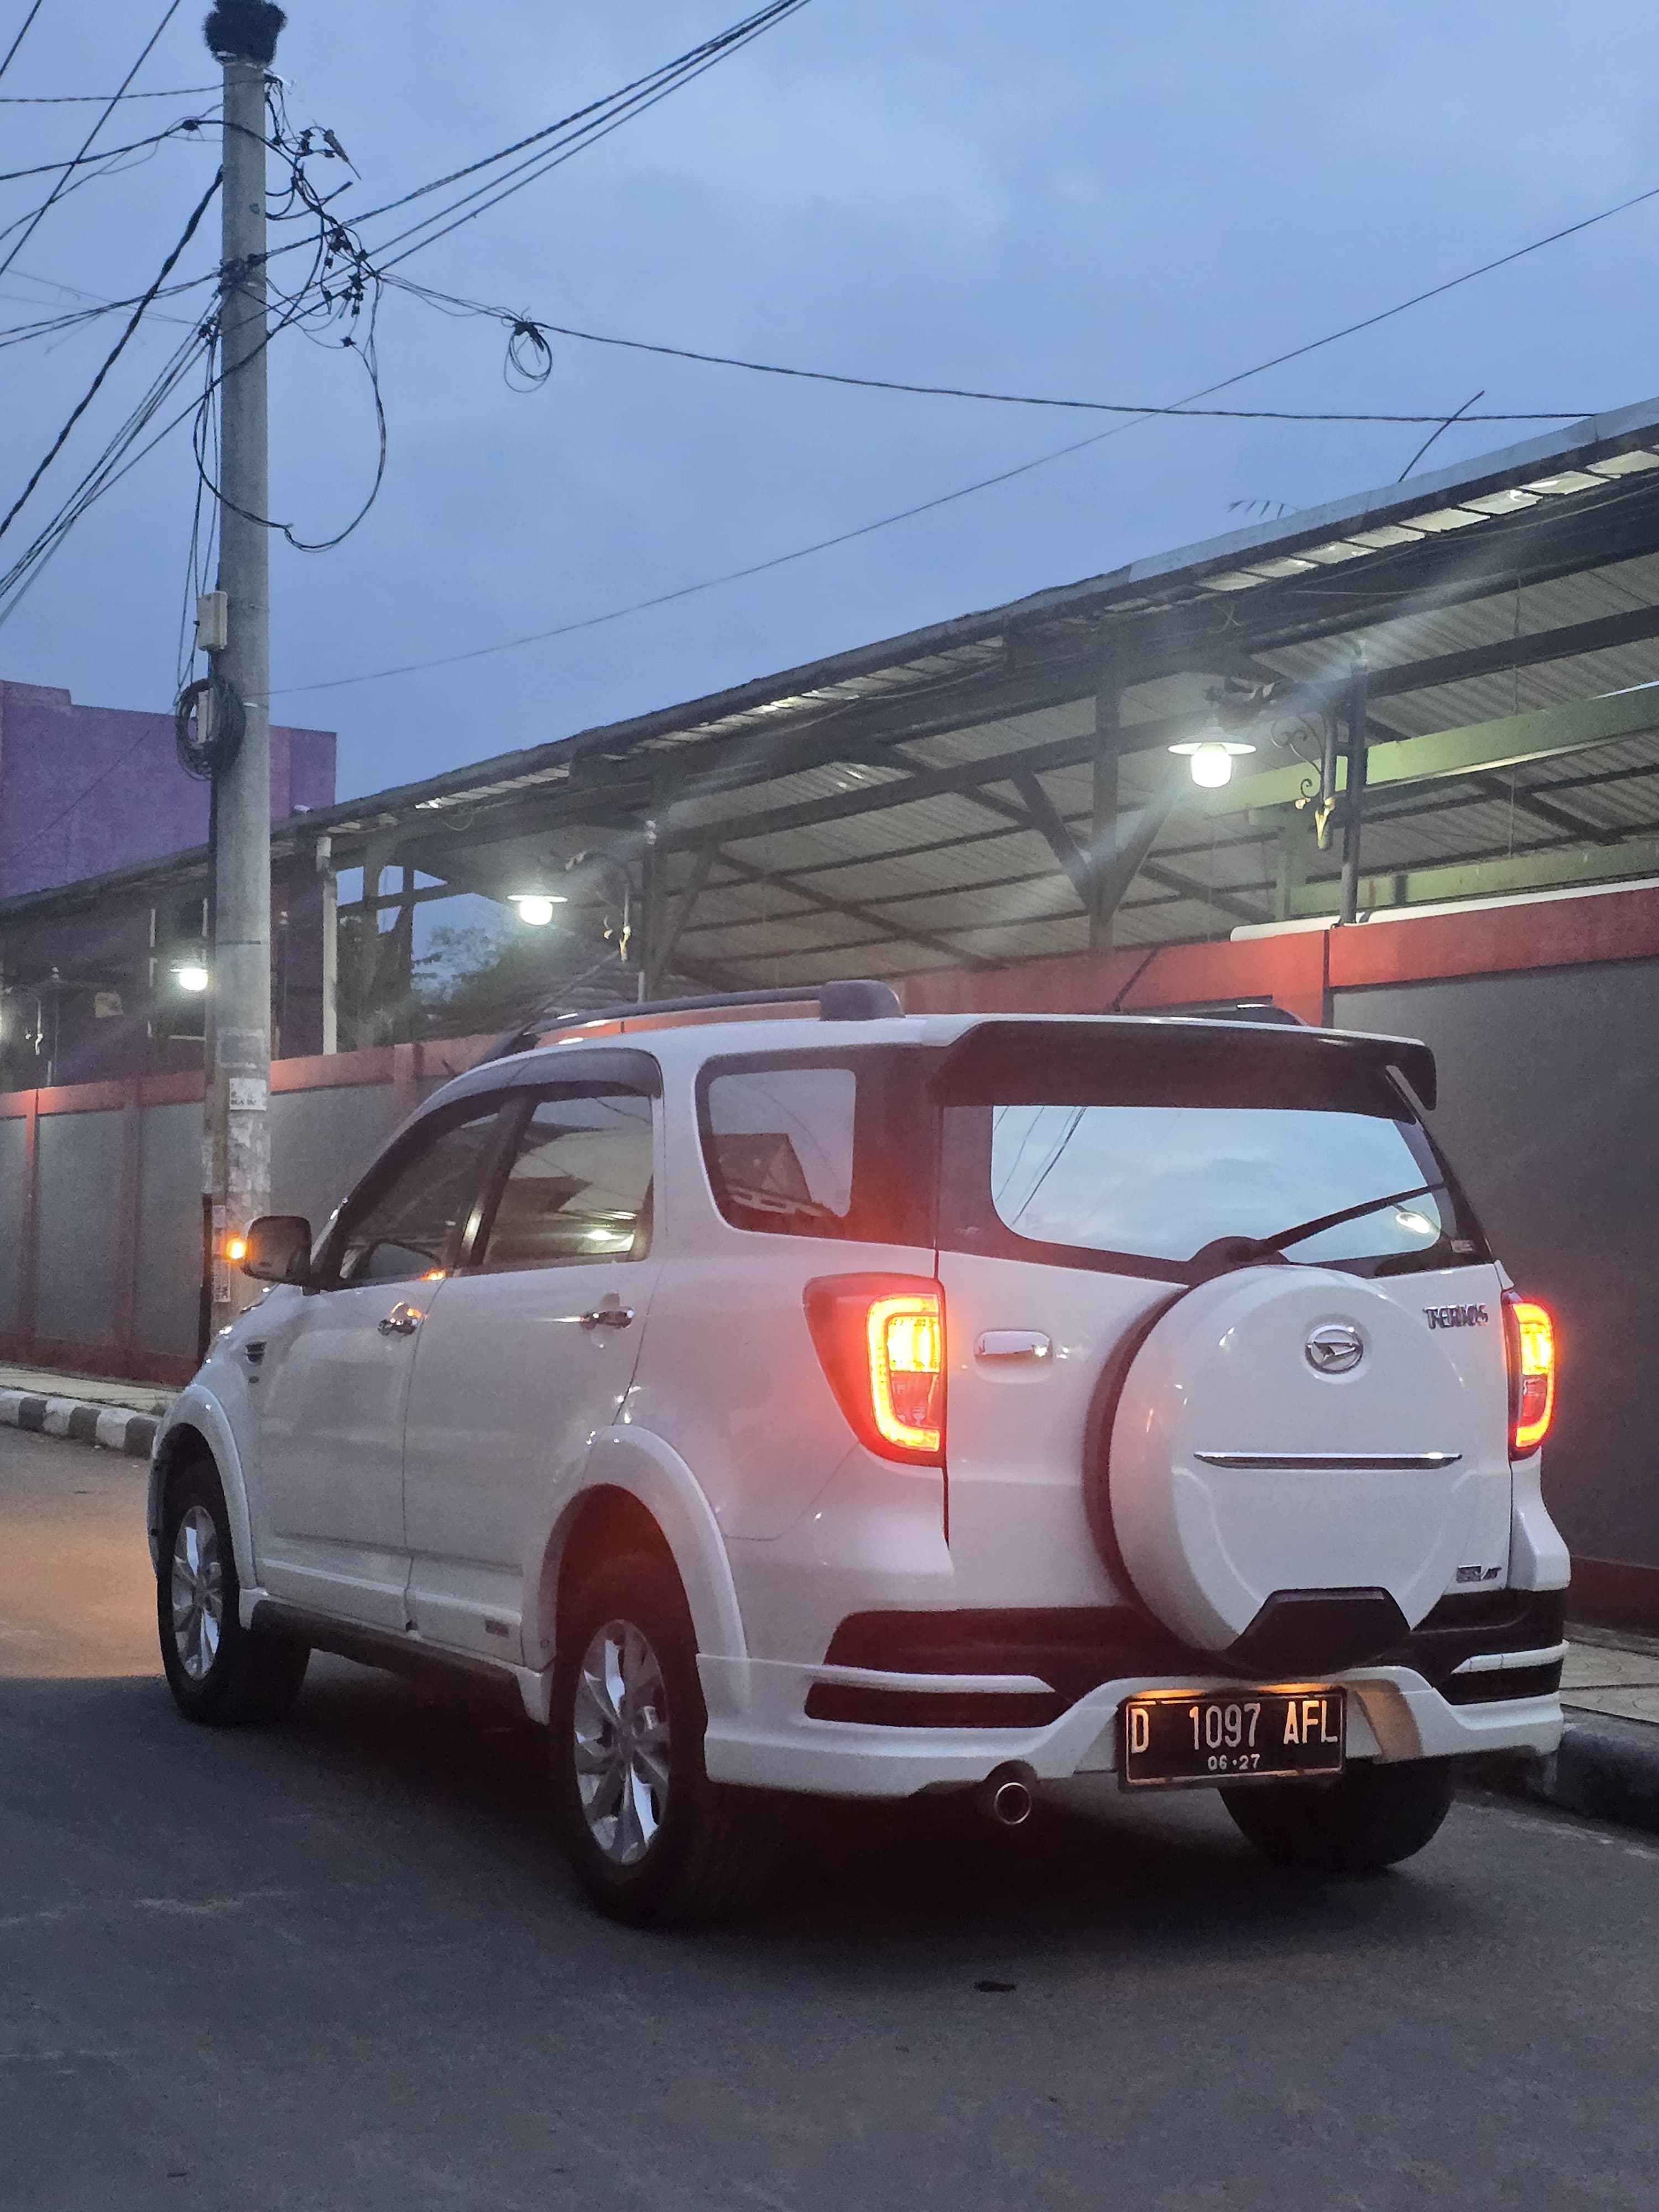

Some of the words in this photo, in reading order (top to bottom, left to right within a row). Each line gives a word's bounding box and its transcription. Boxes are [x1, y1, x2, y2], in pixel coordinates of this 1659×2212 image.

[1131, 1708, 1149, 1754] D
[1190, 1703, 1261, 1750] 1097
[1284, 1700, 1338, 1745] AFL
